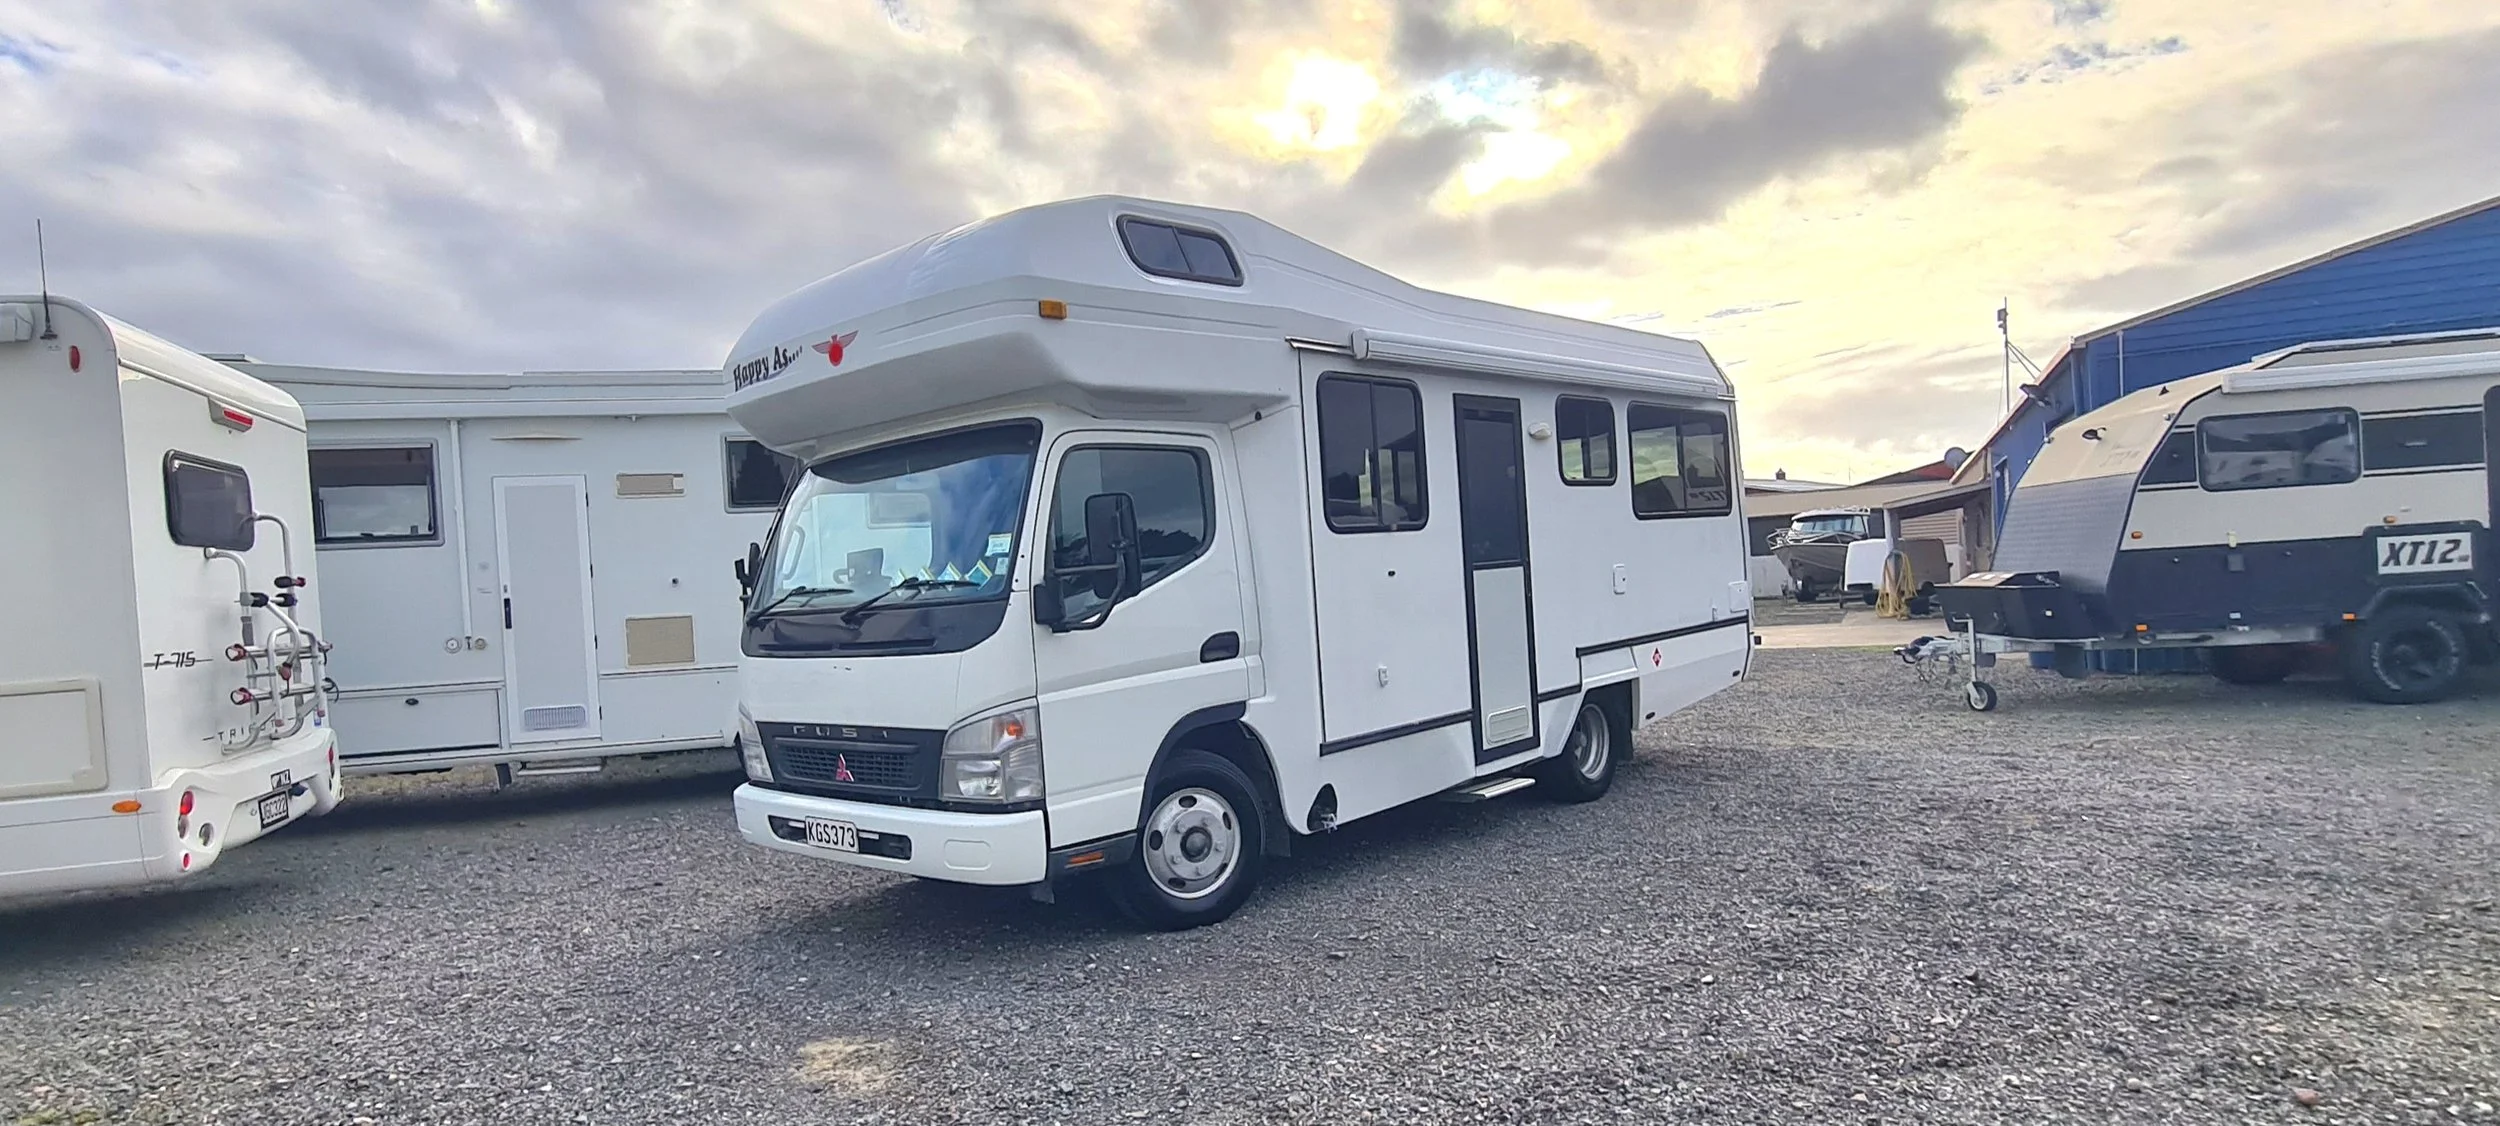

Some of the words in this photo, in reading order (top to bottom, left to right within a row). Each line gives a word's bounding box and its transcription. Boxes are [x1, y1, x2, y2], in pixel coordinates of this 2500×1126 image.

[733, 355, 769, 392] Happy
[2381, 538, 2462, 567] XT12
[153, 650, 196, 670] T-715
[807, 821, 855, 848] KGS373
